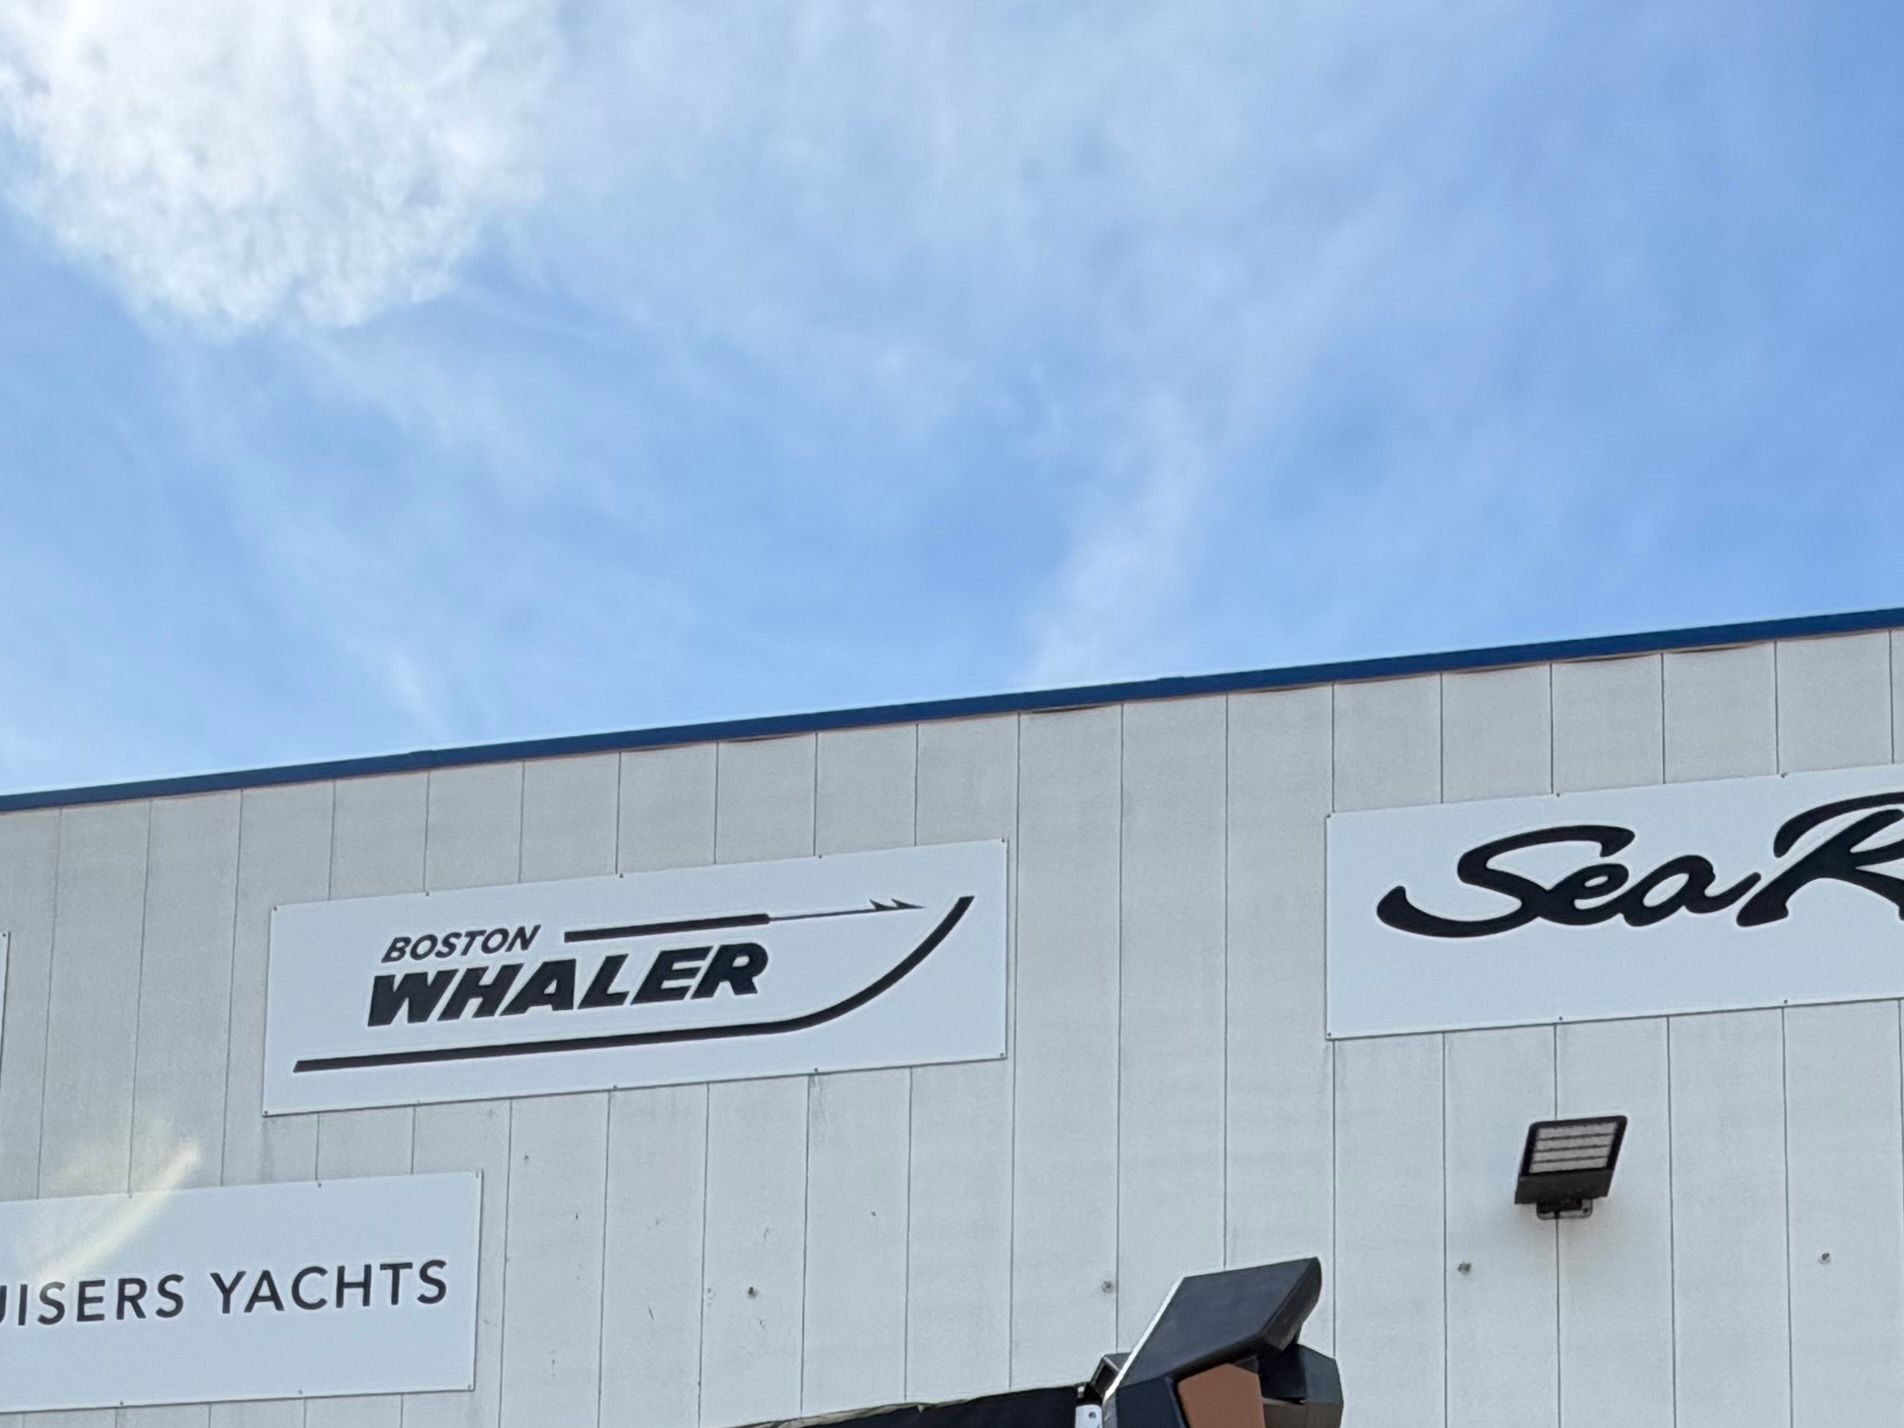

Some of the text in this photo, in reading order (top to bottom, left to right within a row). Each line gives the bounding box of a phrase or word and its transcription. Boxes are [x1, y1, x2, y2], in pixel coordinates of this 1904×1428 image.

[1376, 824, 1761, 939] Sea
[381, 924, 542, 964] BOSTON
[367, 942, 769, 1027] WHALER
[209, 1259, 447, 1314] YACHTS
